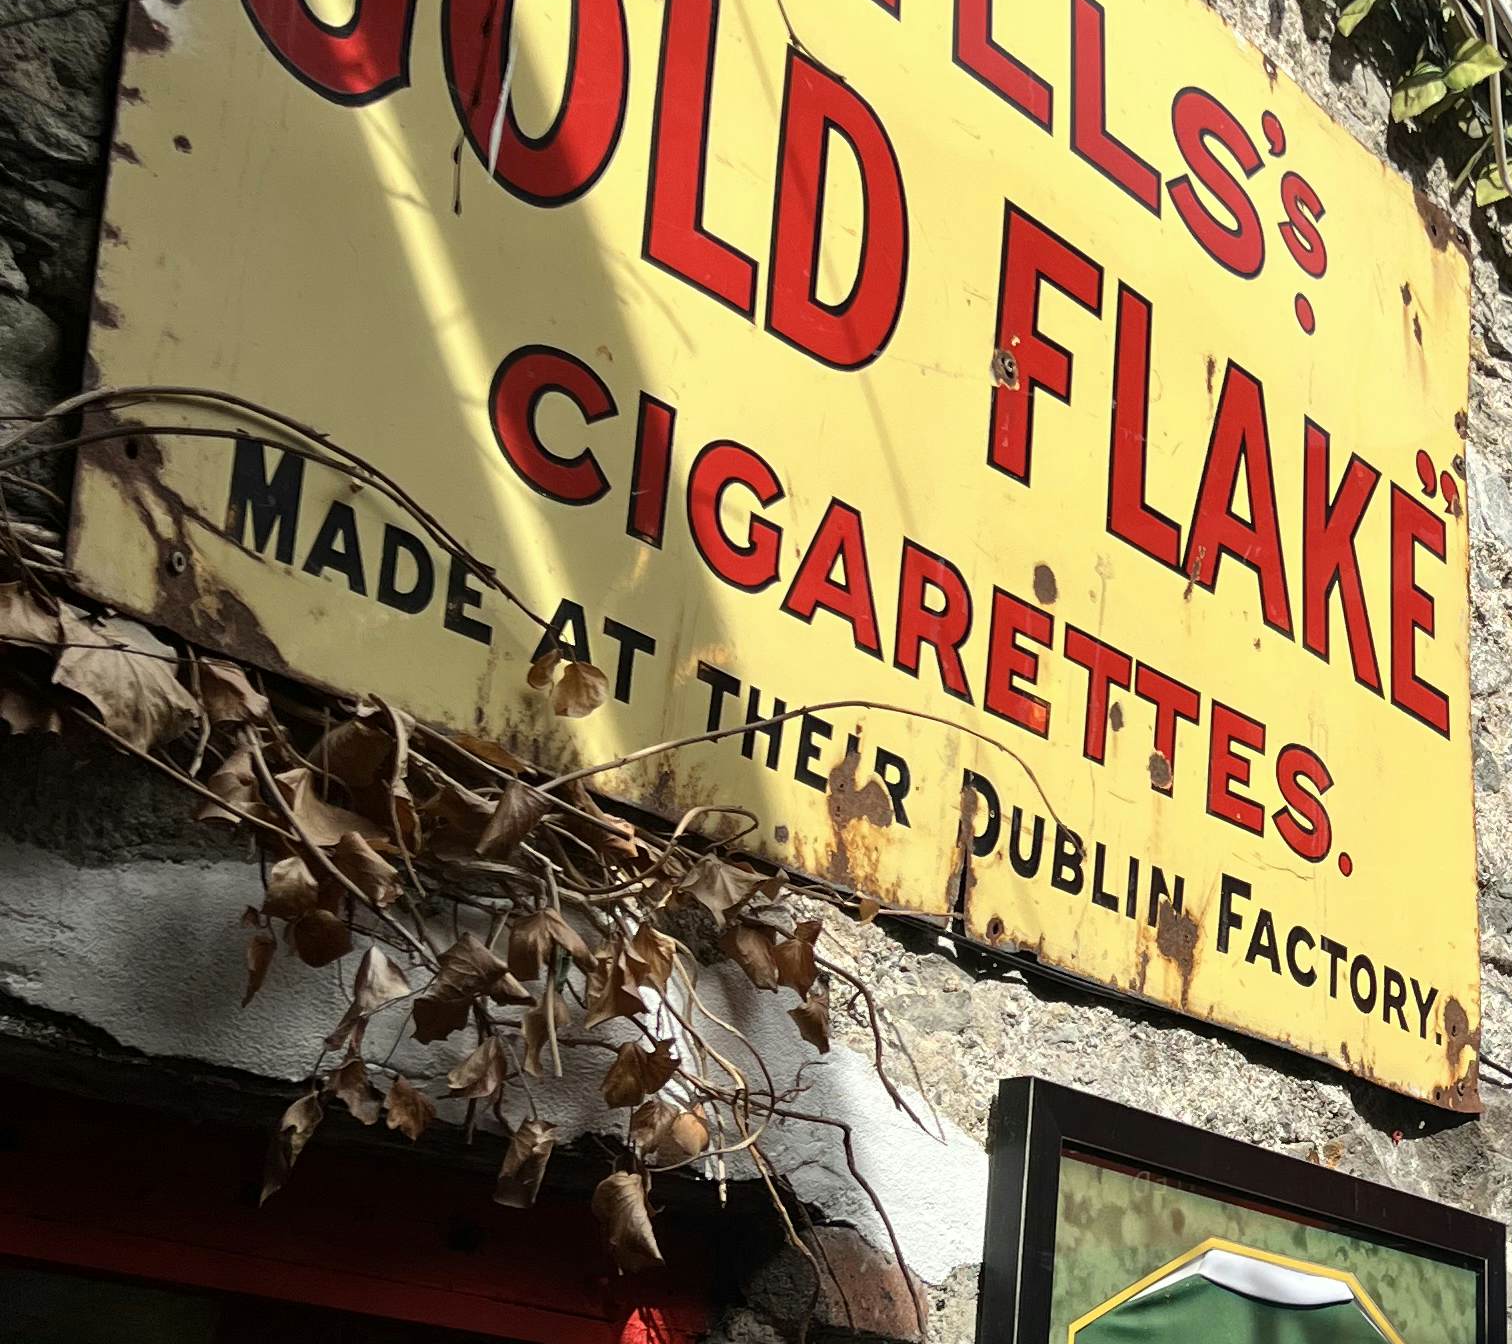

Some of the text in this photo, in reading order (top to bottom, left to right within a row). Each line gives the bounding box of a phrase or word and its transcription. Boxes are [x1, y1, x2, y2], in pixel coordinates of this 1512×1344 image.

[224, 438, 1442, 1046] MADE AT THER DUBLIN FACTORY.
[488, 343, 1353, 878] CIGARETTES.
